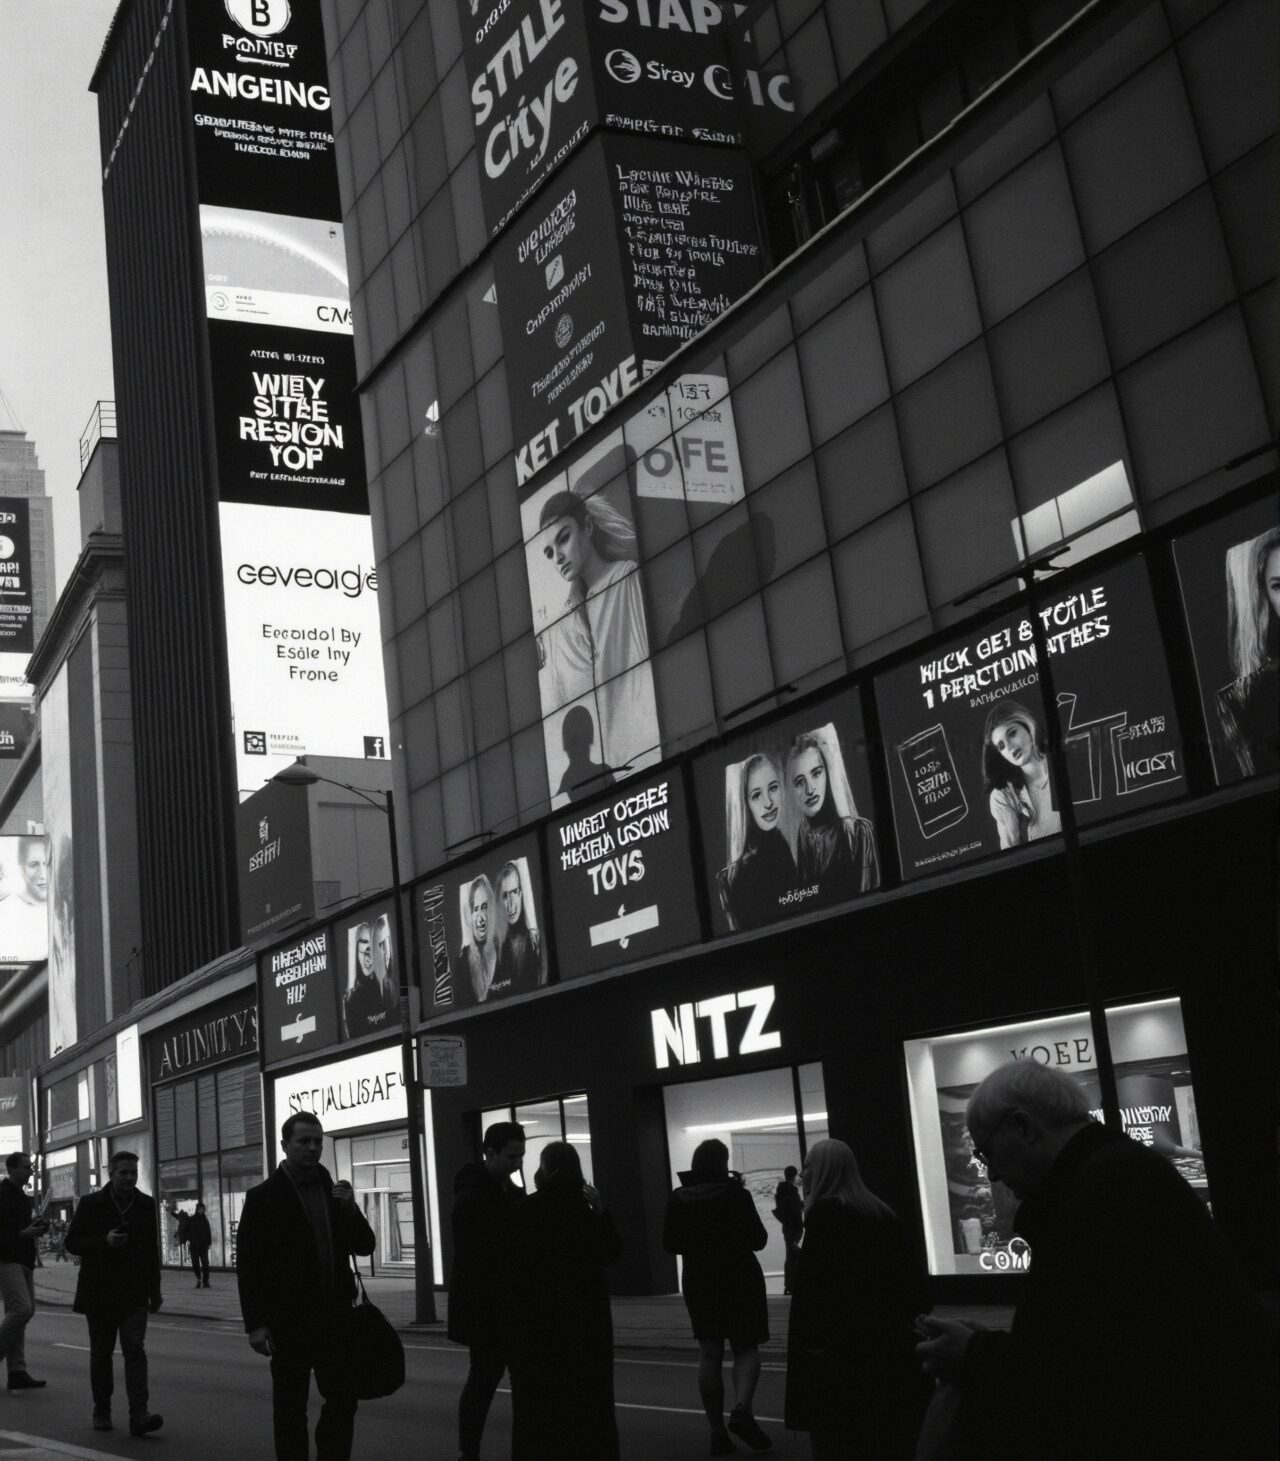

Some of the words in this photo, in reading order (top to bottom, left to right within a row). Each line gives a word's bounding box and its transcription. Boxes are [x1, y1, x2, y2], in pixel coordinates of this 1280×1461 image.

[190, 67, 331, 111] ANGEING
[341, 629, 361, 648] By
[587, 849, 646, 896] TOYS
